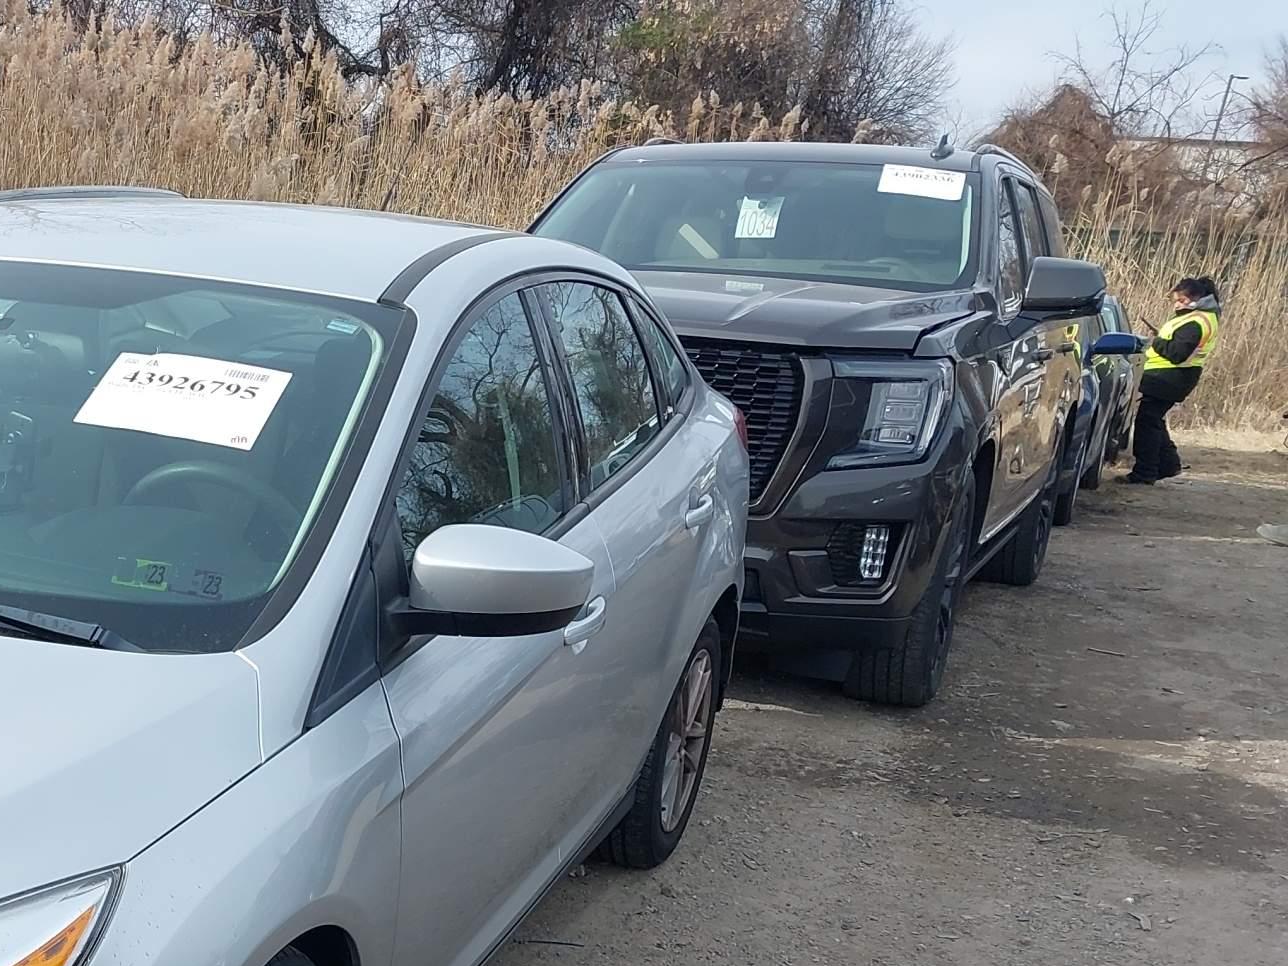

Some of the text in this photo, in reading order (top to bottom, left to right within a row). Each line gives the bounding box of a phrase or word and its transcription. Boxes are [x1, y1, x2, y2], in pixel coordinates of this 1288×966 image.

[740, 210, 775, 236] 1034
[122, 369, 261, 400] 43926795
[146, 564, 167, 585] 23
[202, 575, 223, 596] 23
